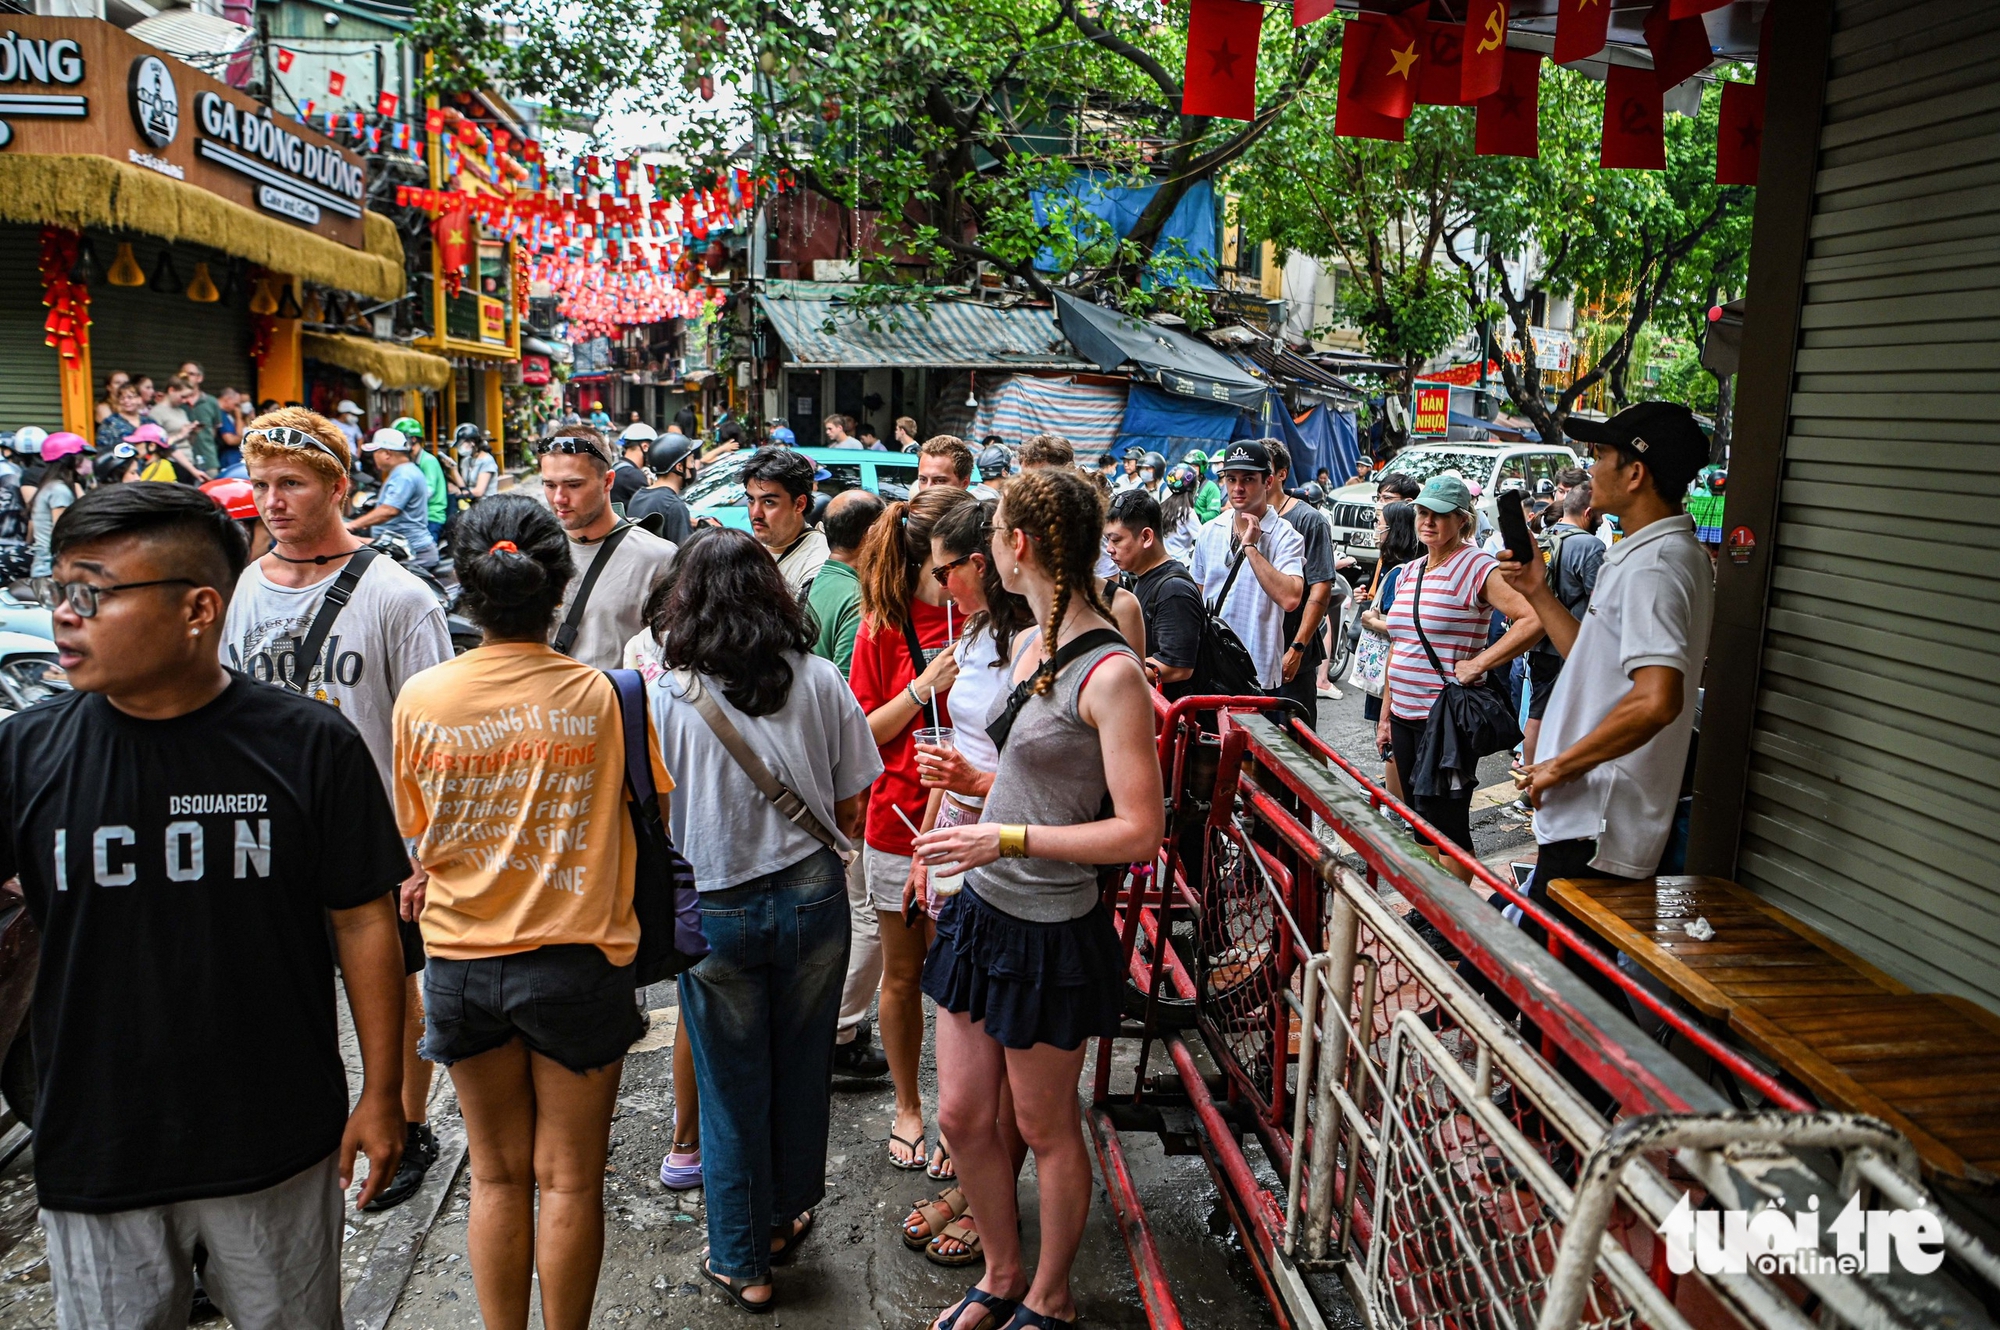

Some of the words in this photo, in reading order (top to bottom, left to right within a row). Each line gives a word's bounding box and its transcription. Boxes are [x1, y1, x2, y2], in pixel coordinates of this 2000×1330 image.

[201, 91, 240, 145] GA
[241, 106, 302, 173] ĐÔNG
[1421, 394, 1444, 412] HÀN
[1416, 413, 1446, 431] NHỰA
[1738, 530, 1745, 544] 1
[169, 793, 268, 816] DSQUARED2
[54, 818, 271, 892] ICON
